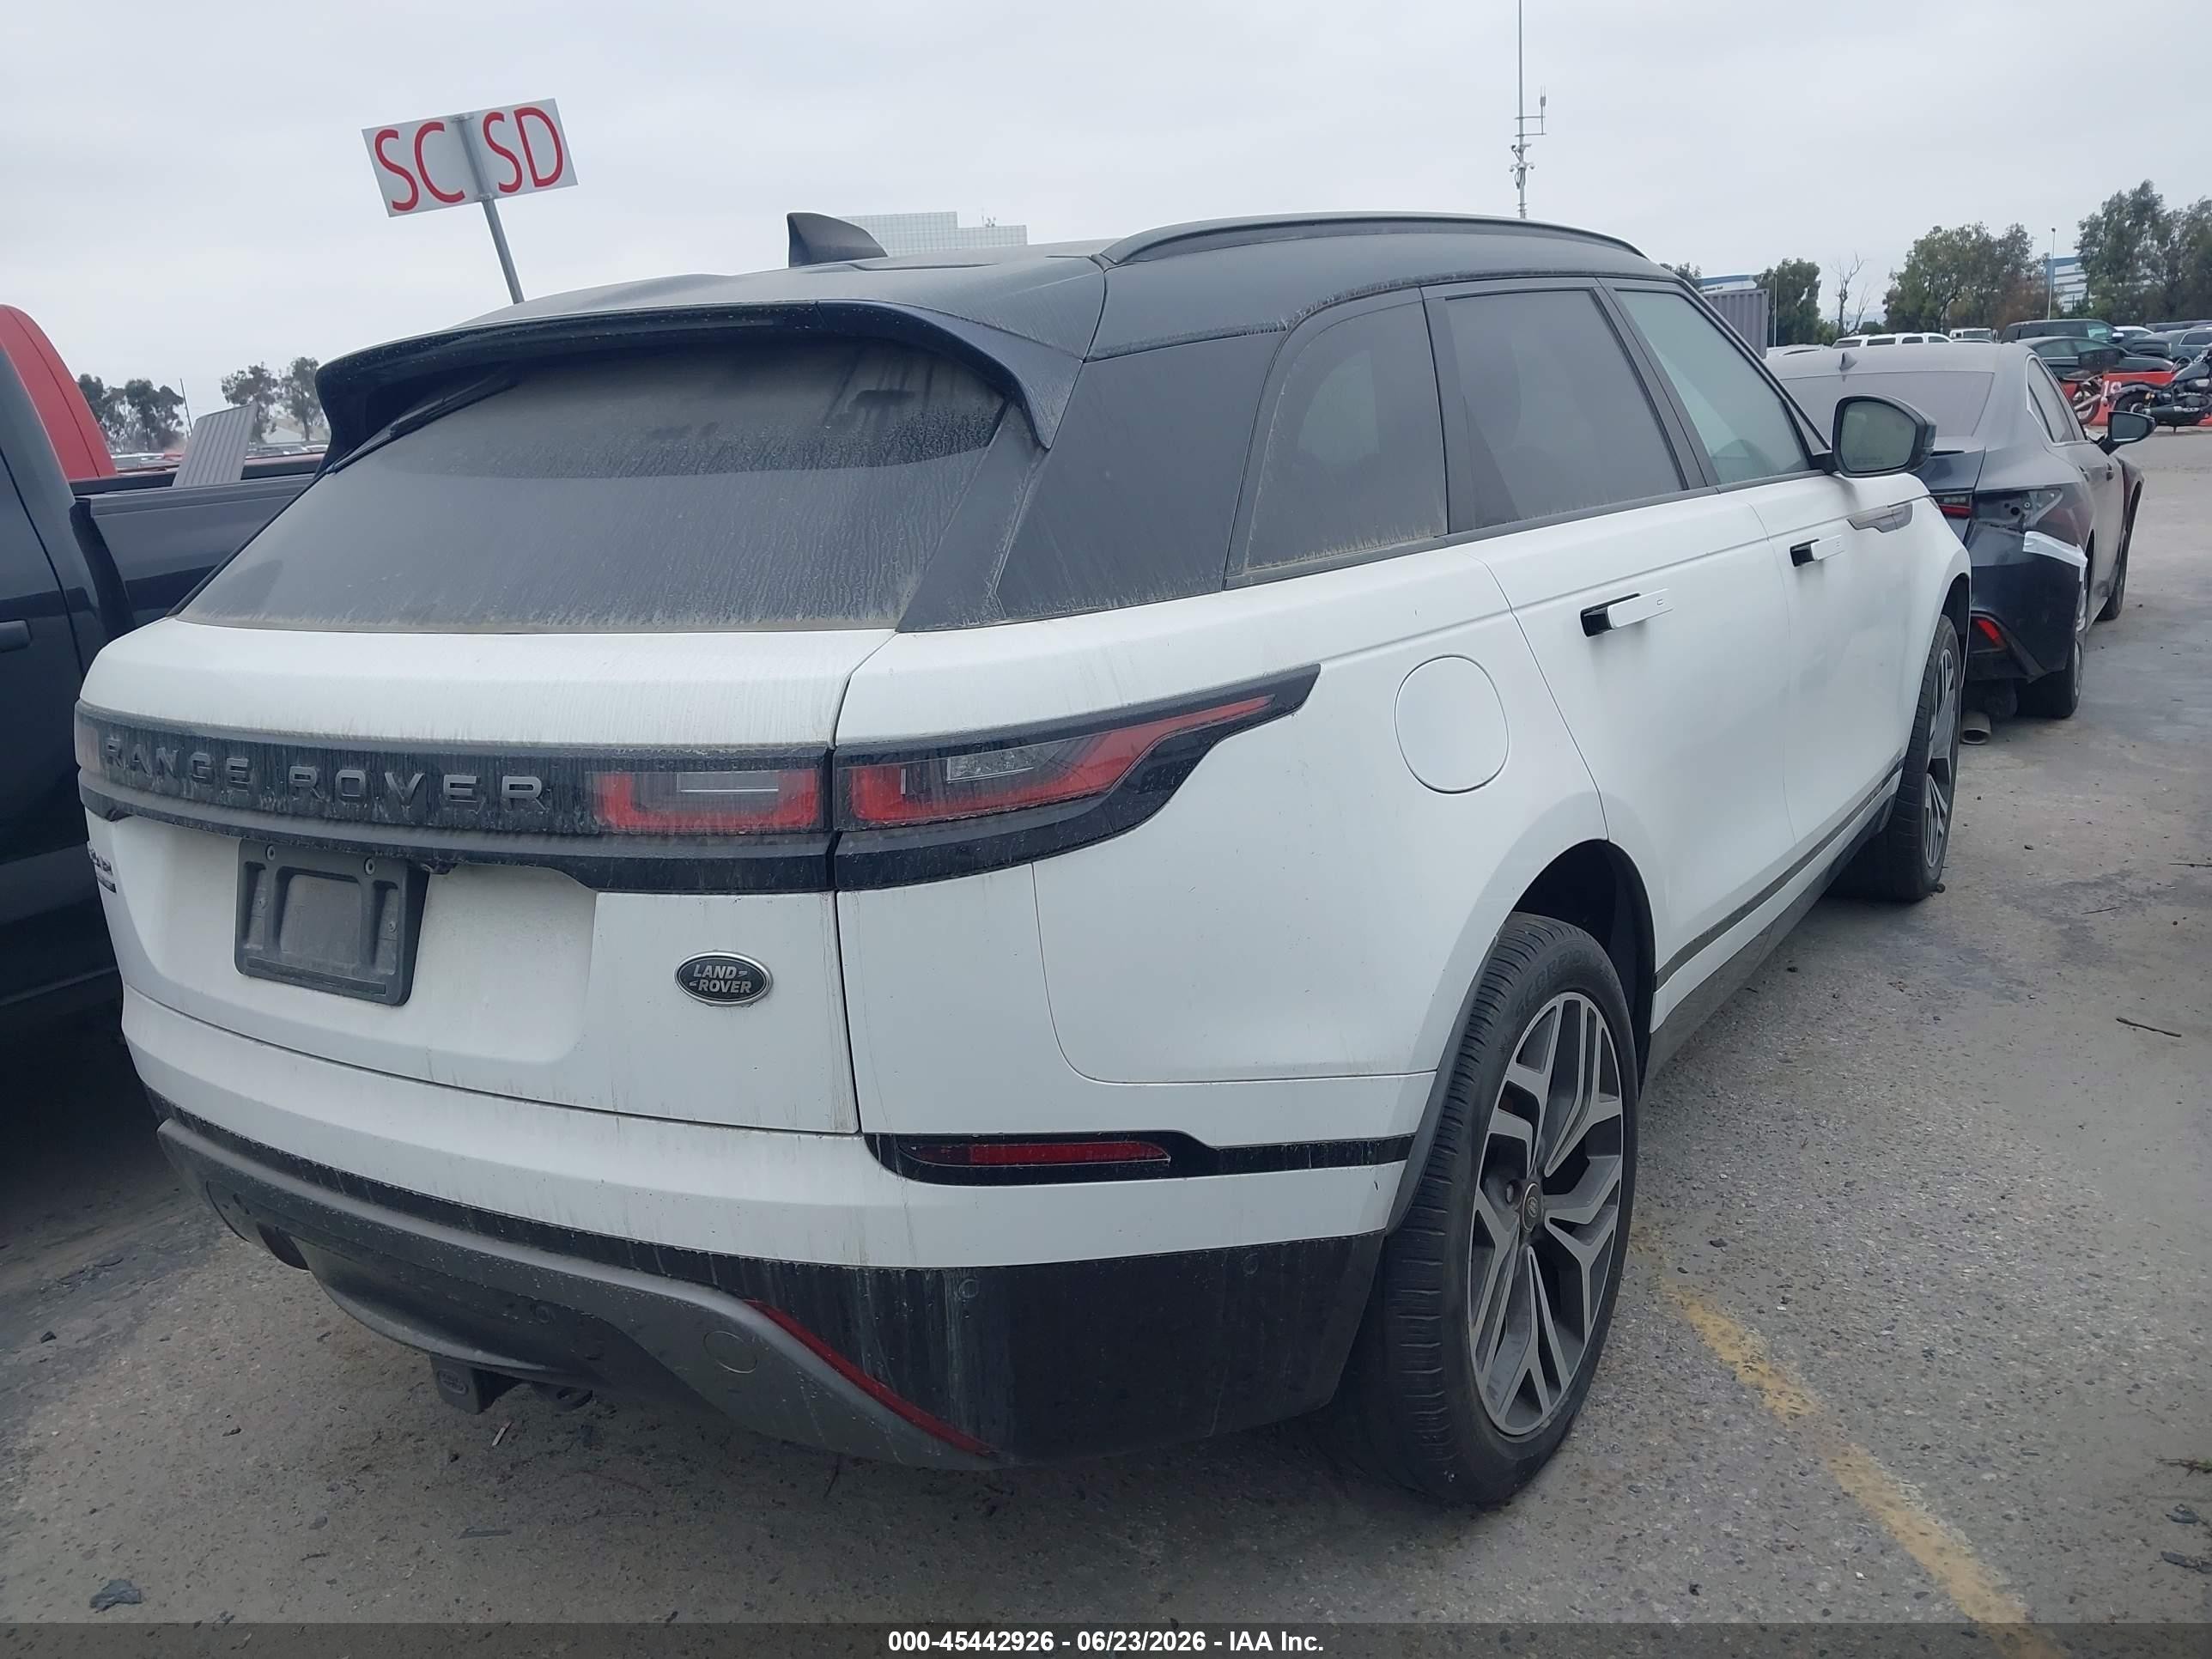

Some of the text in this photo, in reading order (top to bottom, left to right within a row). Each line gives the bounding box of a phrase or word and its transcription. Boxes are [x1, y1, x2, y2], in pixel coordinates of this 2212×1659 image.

[374, 106, 564, 212] SC SD
[106, 735, 547, 811] RANGE ROVER
[693, 964, 737, 979] LAND
[697, 980, 752, 994] ROVER
